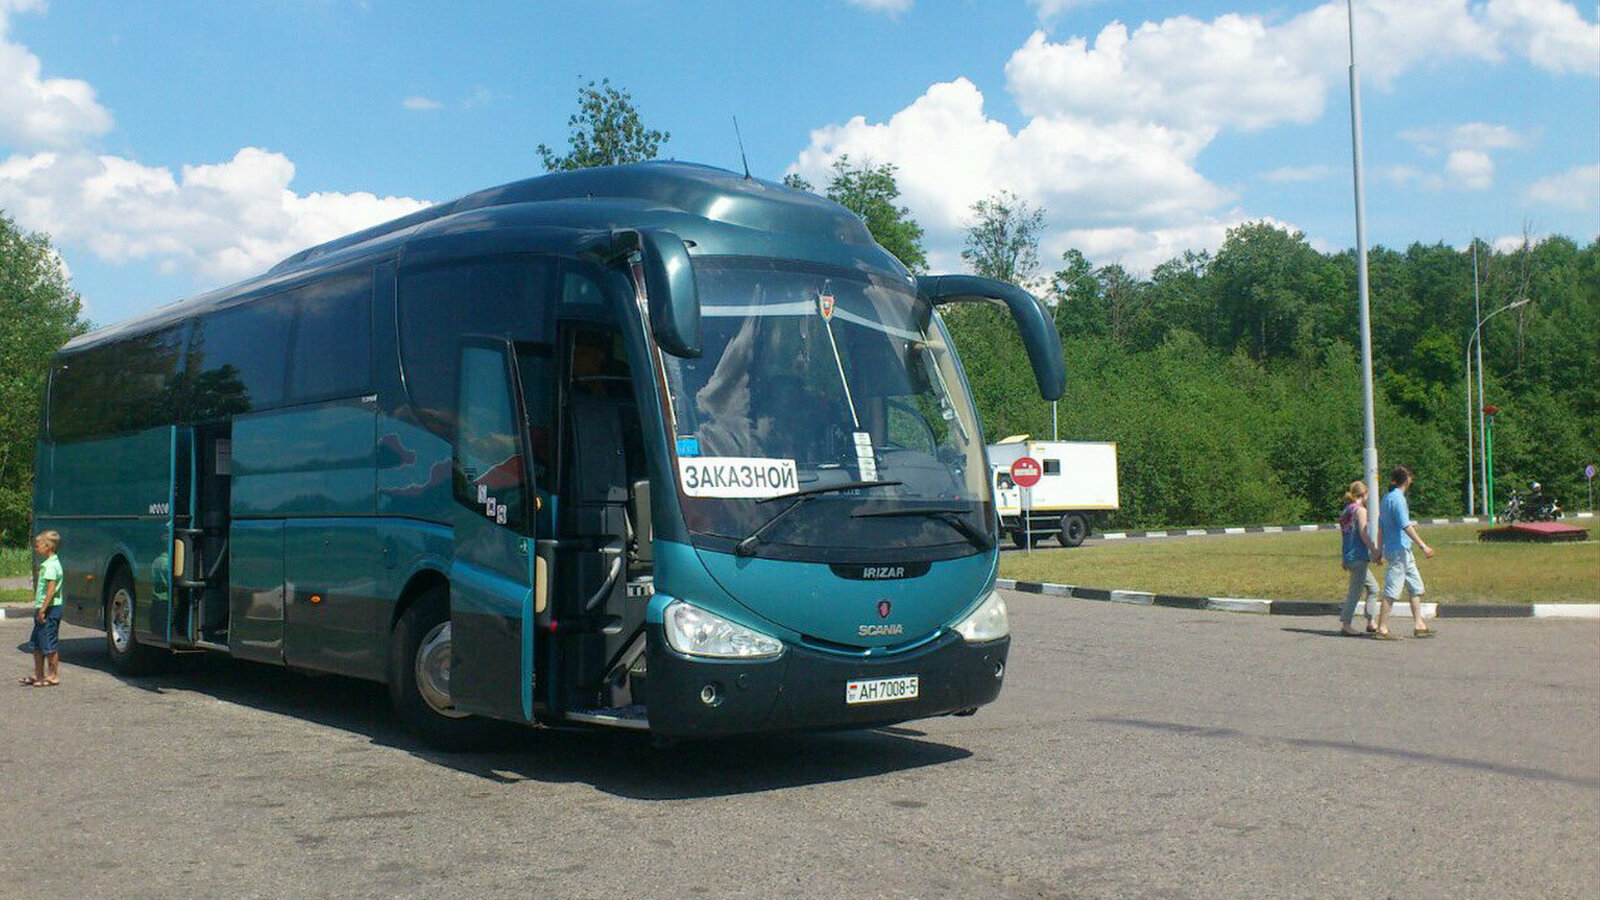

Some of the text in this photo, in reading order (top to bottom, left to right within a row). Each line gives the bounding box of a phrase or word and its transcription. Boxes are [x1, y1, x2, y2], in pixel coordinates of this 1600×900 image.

[685, 462, 795, 489] ЗАКАЗНОЙ
[862, 566, 905, 578] IRIZAR
[858, 623, 904, 636] SCANIA
